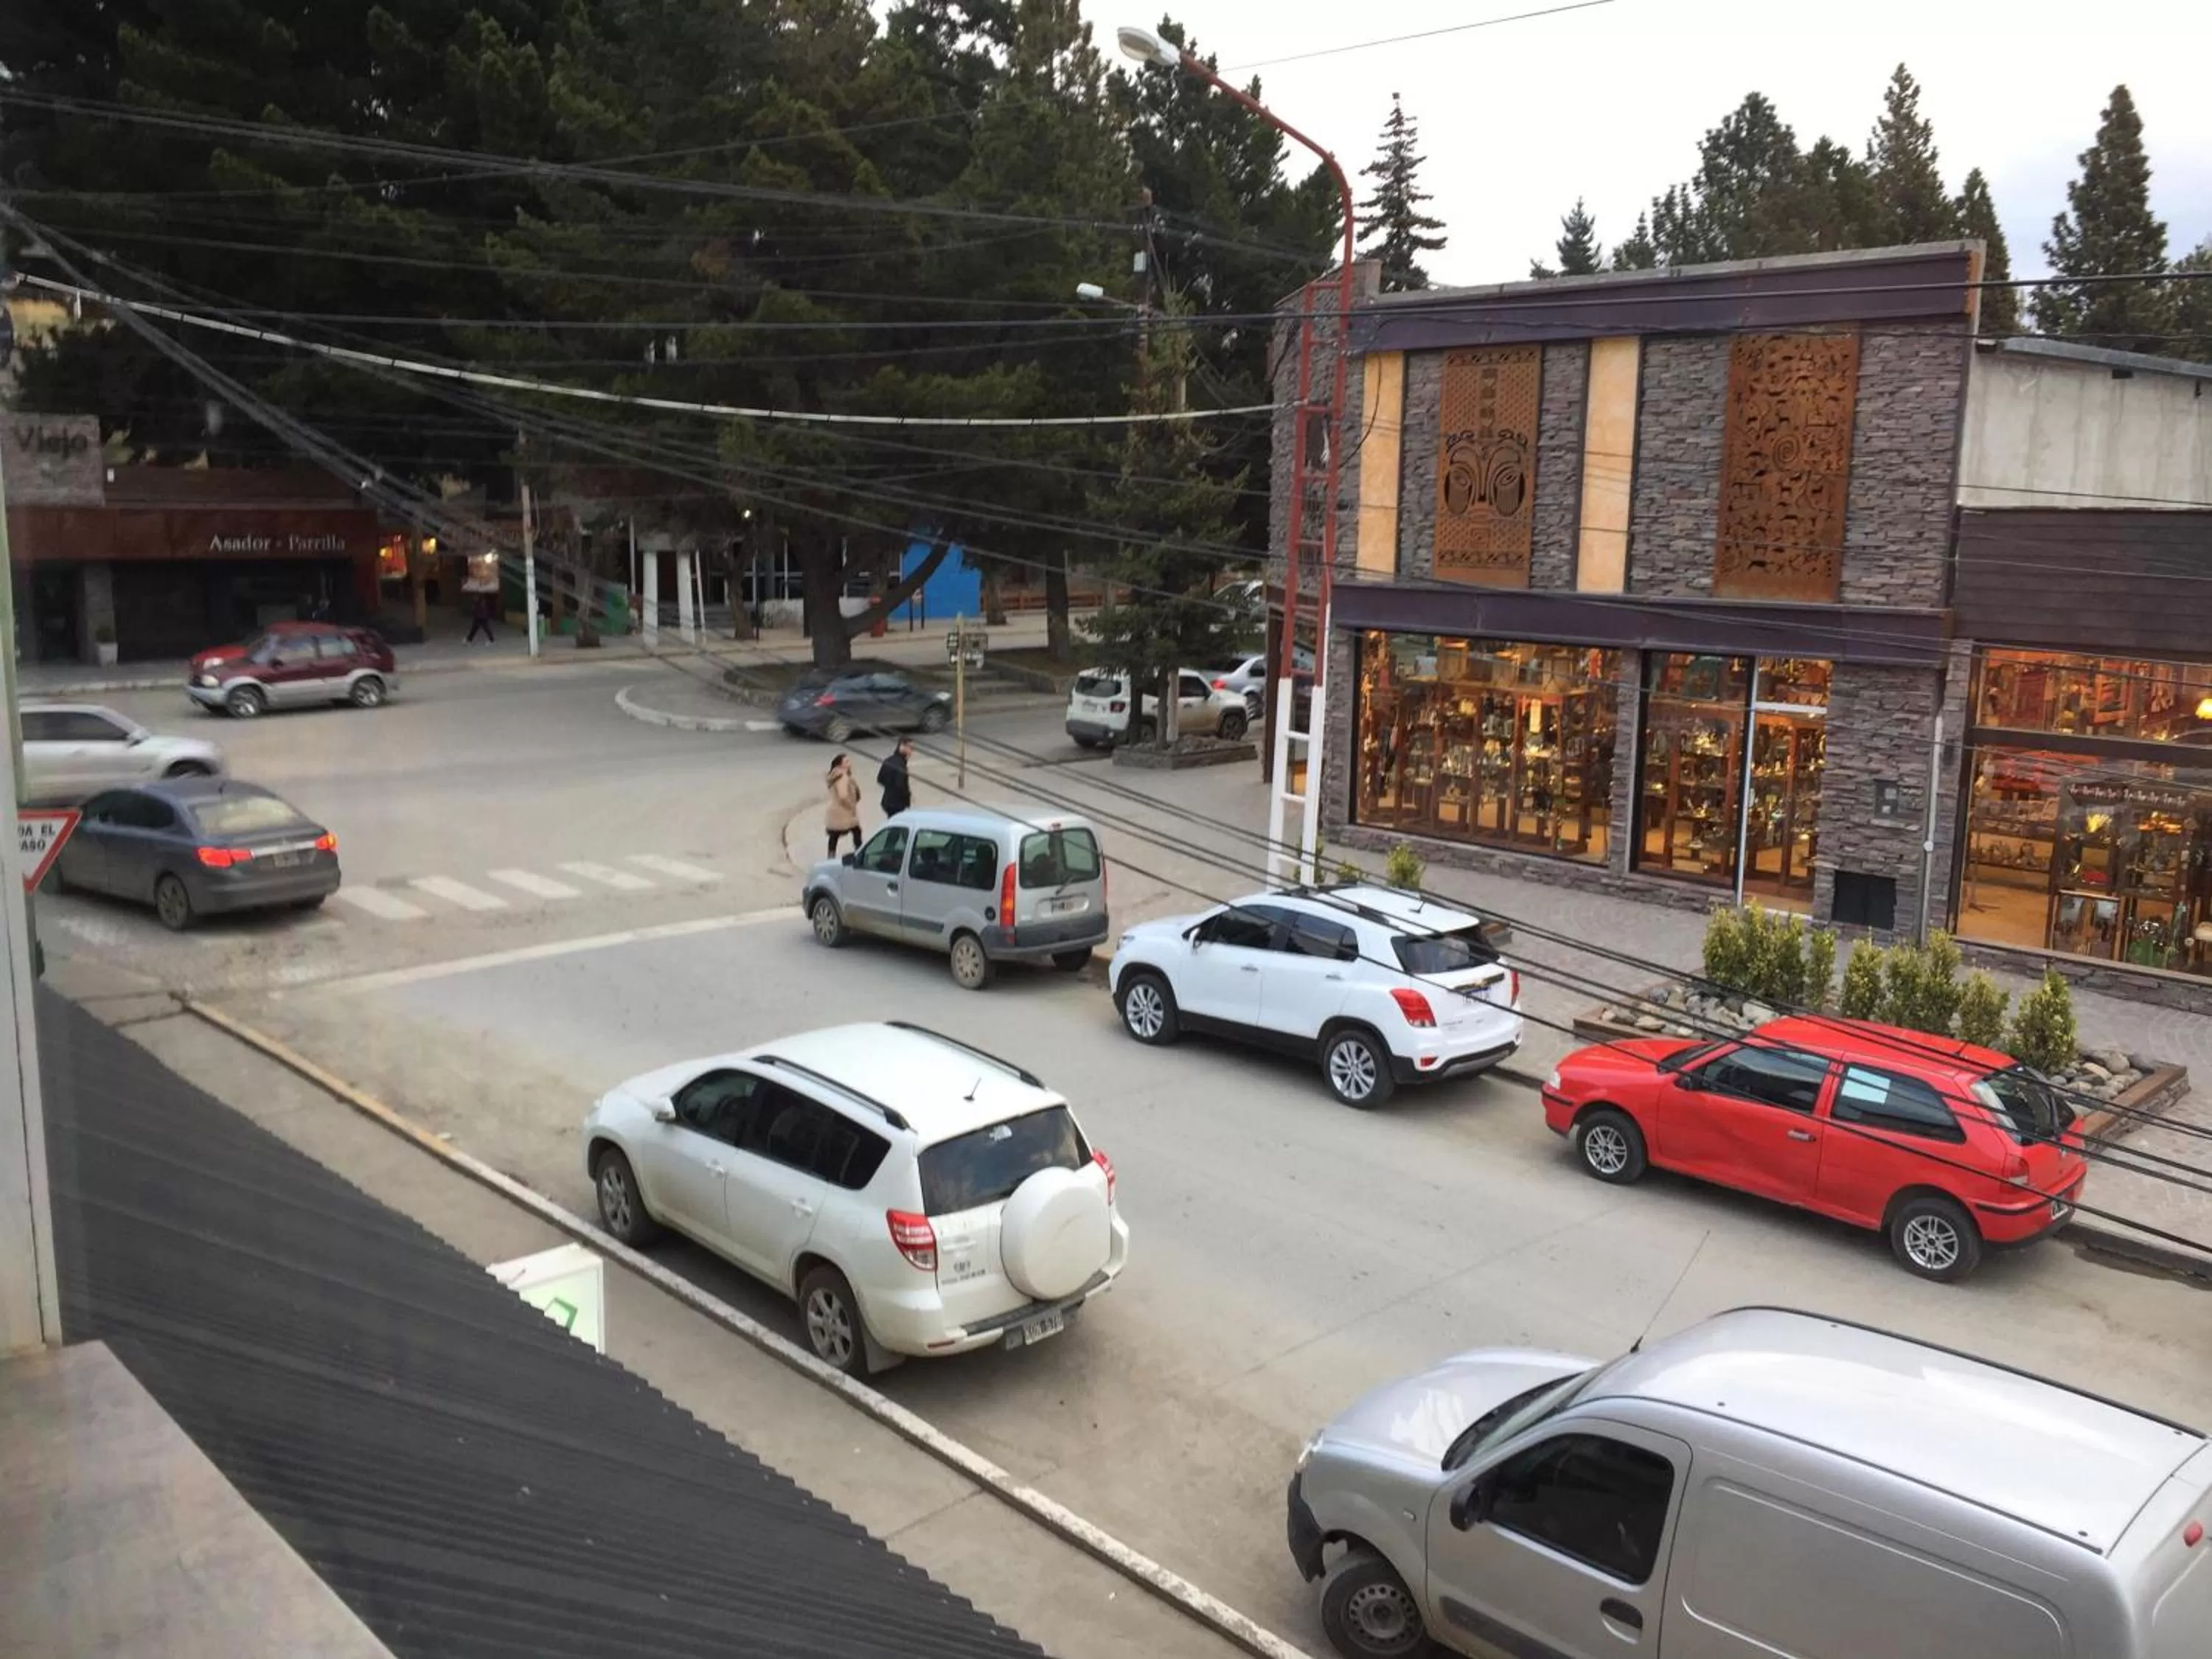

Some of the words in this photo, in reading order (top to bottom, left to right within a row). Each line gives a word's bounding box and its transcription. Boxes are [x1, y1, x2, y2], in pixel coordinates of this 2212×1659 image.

[209, 534, 271, 552] Asador
[289, 534, 346, 553] Parrilla
[19, 839, 46, 852] ASO
